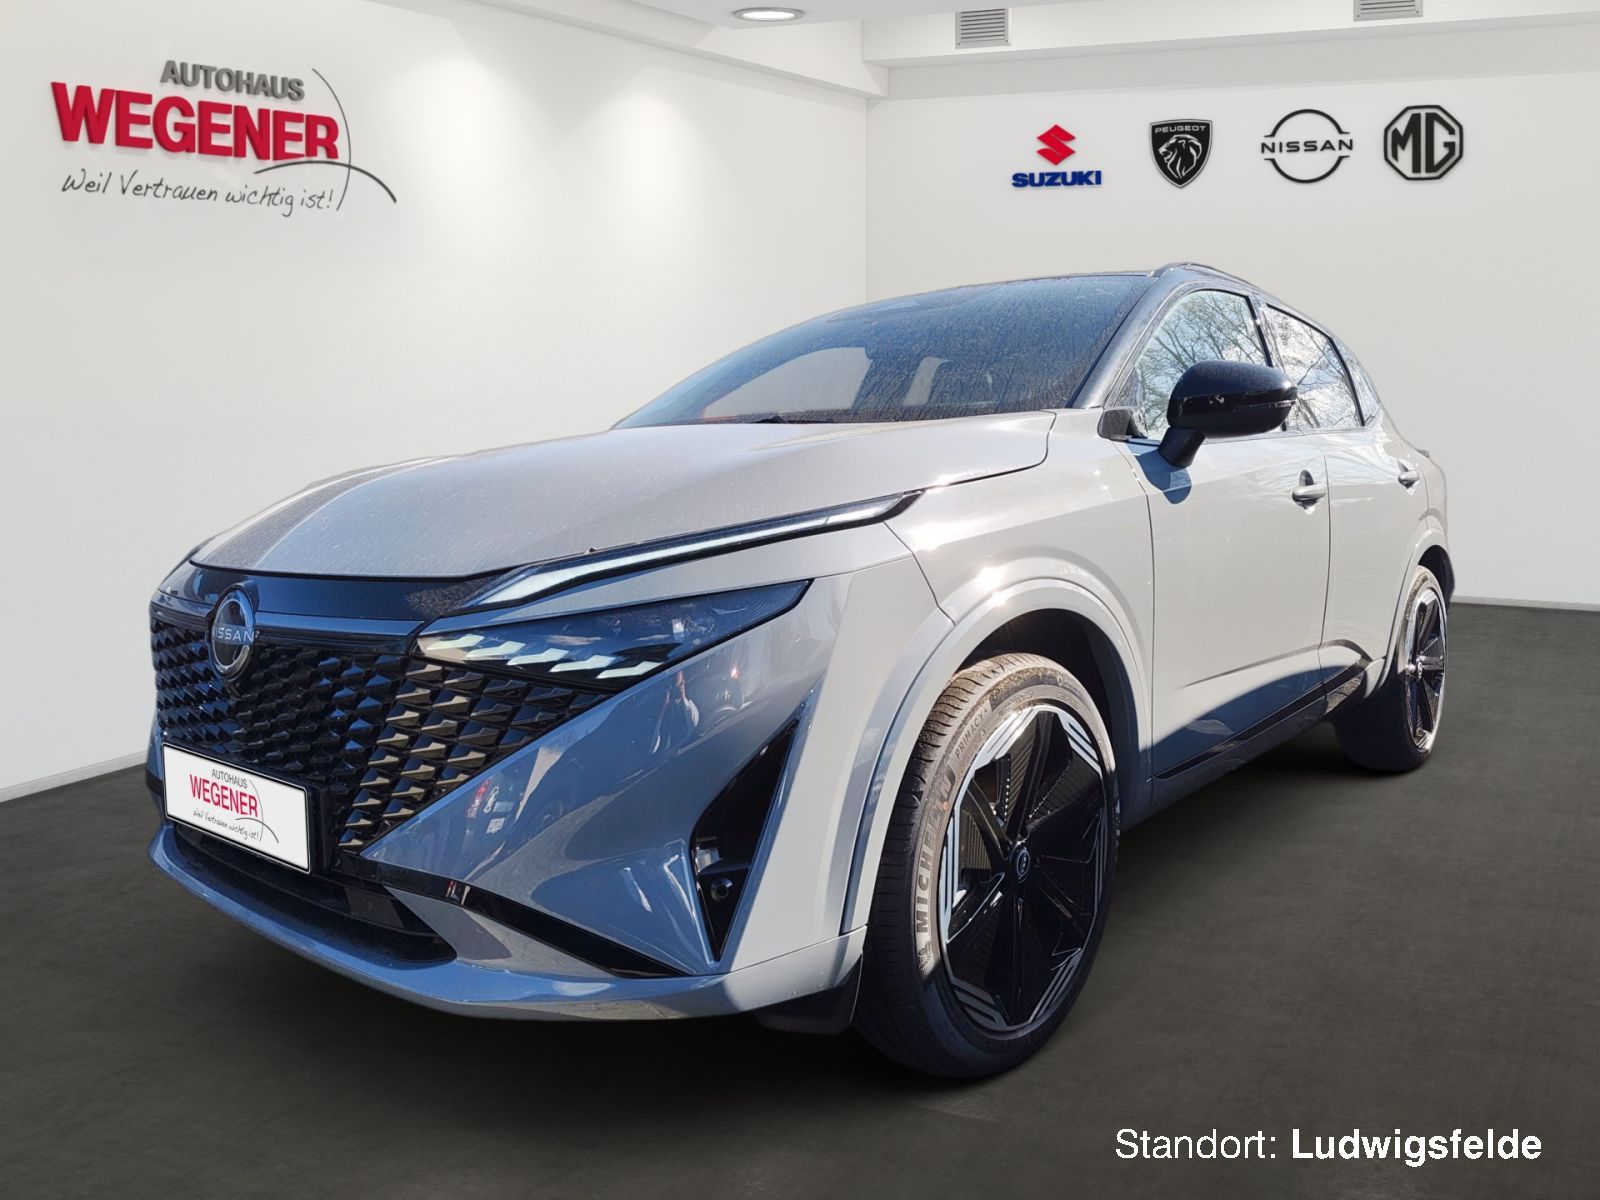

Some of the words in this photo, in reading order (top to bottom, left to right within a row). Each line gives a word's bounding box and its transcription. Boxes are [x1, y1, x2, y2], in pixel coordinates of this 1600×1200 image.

[159, 60, 305, 102] AUTOHAUS
[51, 81, 340, 162] WEGENER
[1154, 124, 1207, 134] PEUGEOT
[1391, 112, 1456, 174] MG
[1261, 138, 1354, 154] NISSAN
[61, 168, 112, 194] Weil
[120, 169, 218, 201] Vertrauen
[225, 184, 294, 218] wichtig
[300, 188, 334, 210] ist!
[1011, 170, 1102, 188] SUZUKI
[955, 712, 985, 760] PRIMACY
[189, 774, 259, 818] WEGENER
[211, 768, 248, 790] AUTOHAUS
